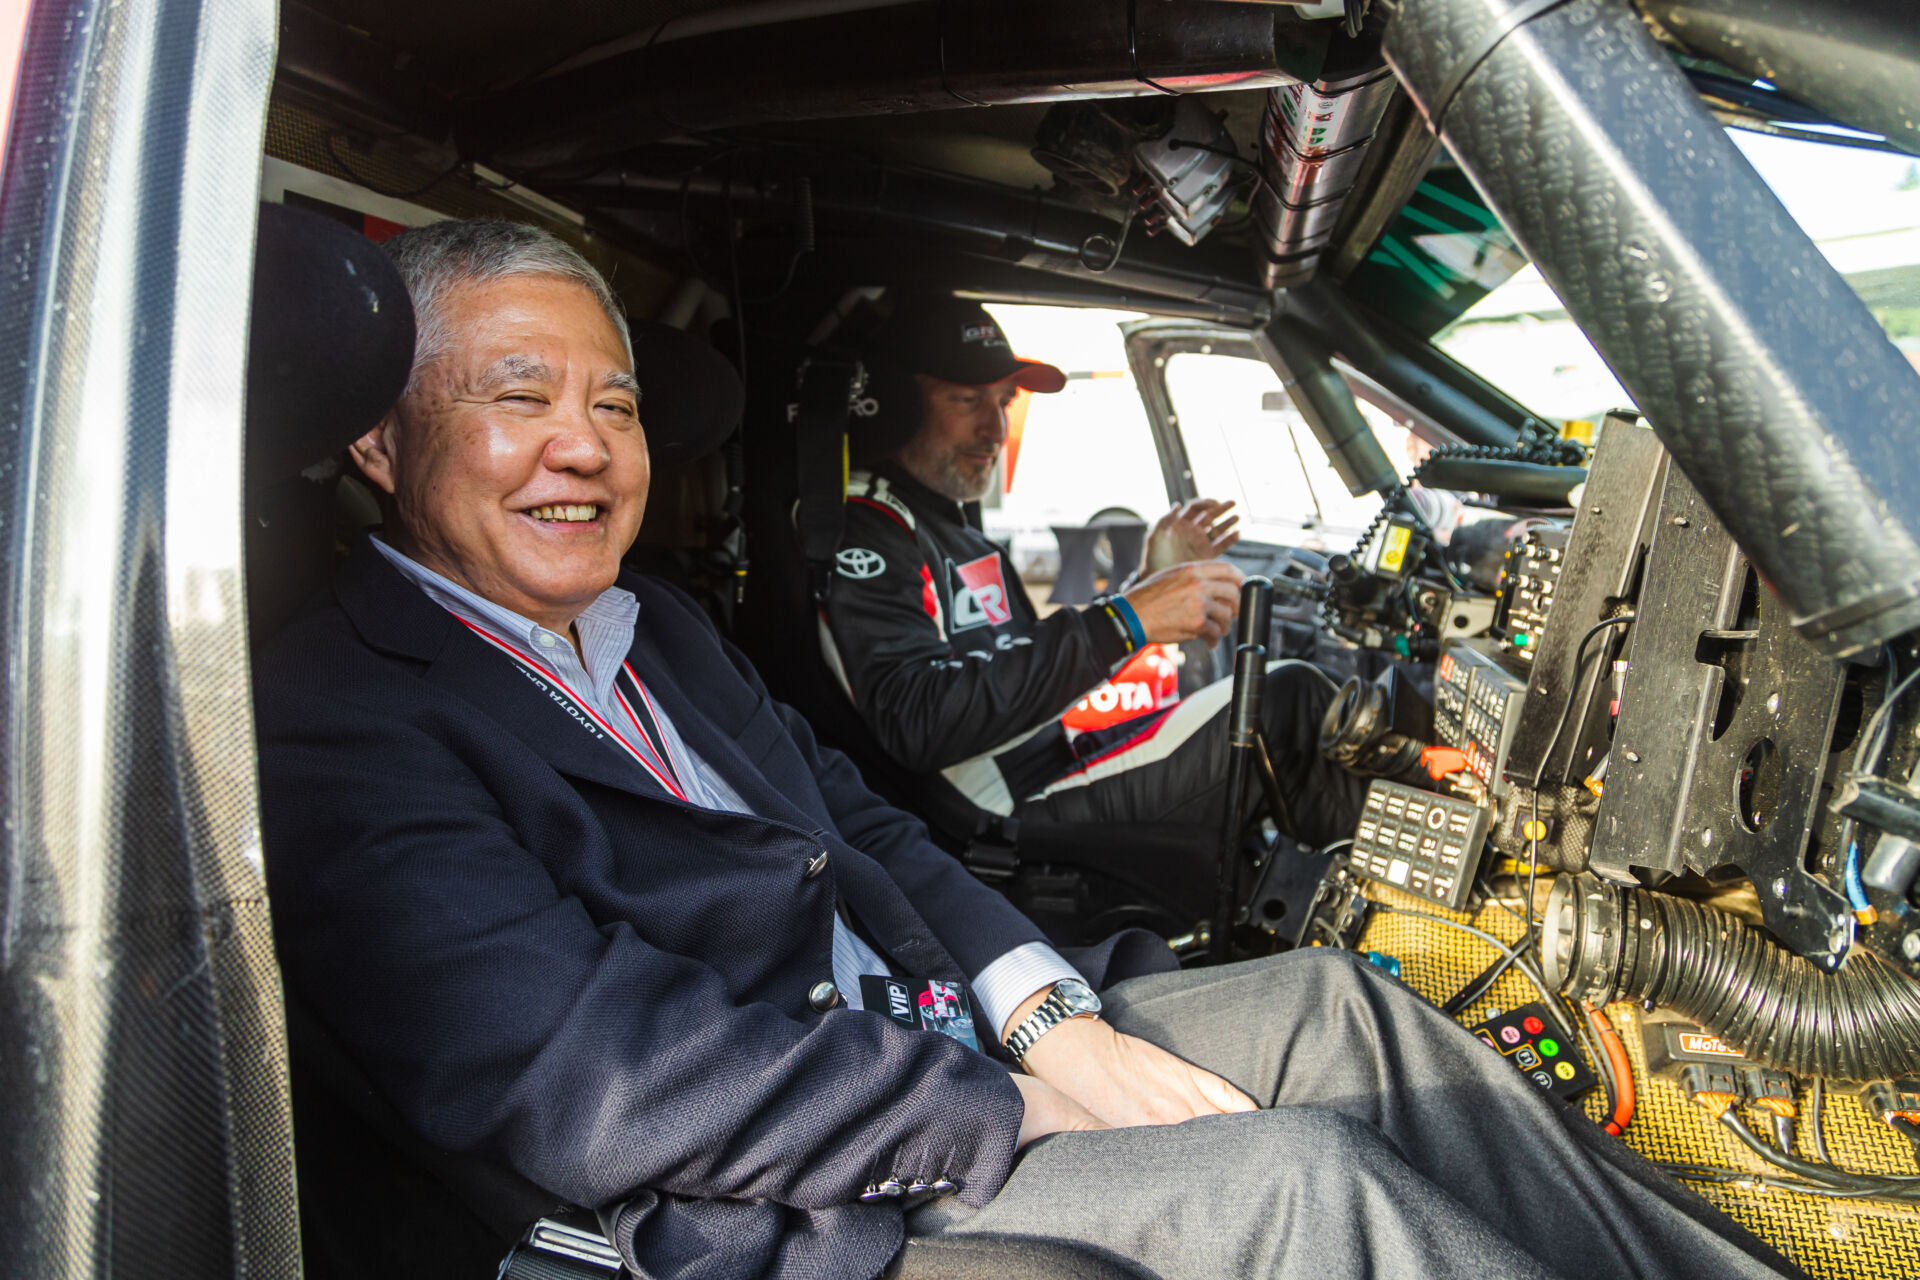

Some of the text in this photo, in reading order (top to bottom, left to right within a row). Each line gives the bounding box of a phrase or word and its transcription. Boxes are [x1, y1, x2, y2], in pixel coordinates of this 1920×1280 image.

[954, 583, 1007, 627] GR
[889, 985, 910, 1015] VIP
[1519, 1051, 1534, 1064] F1
